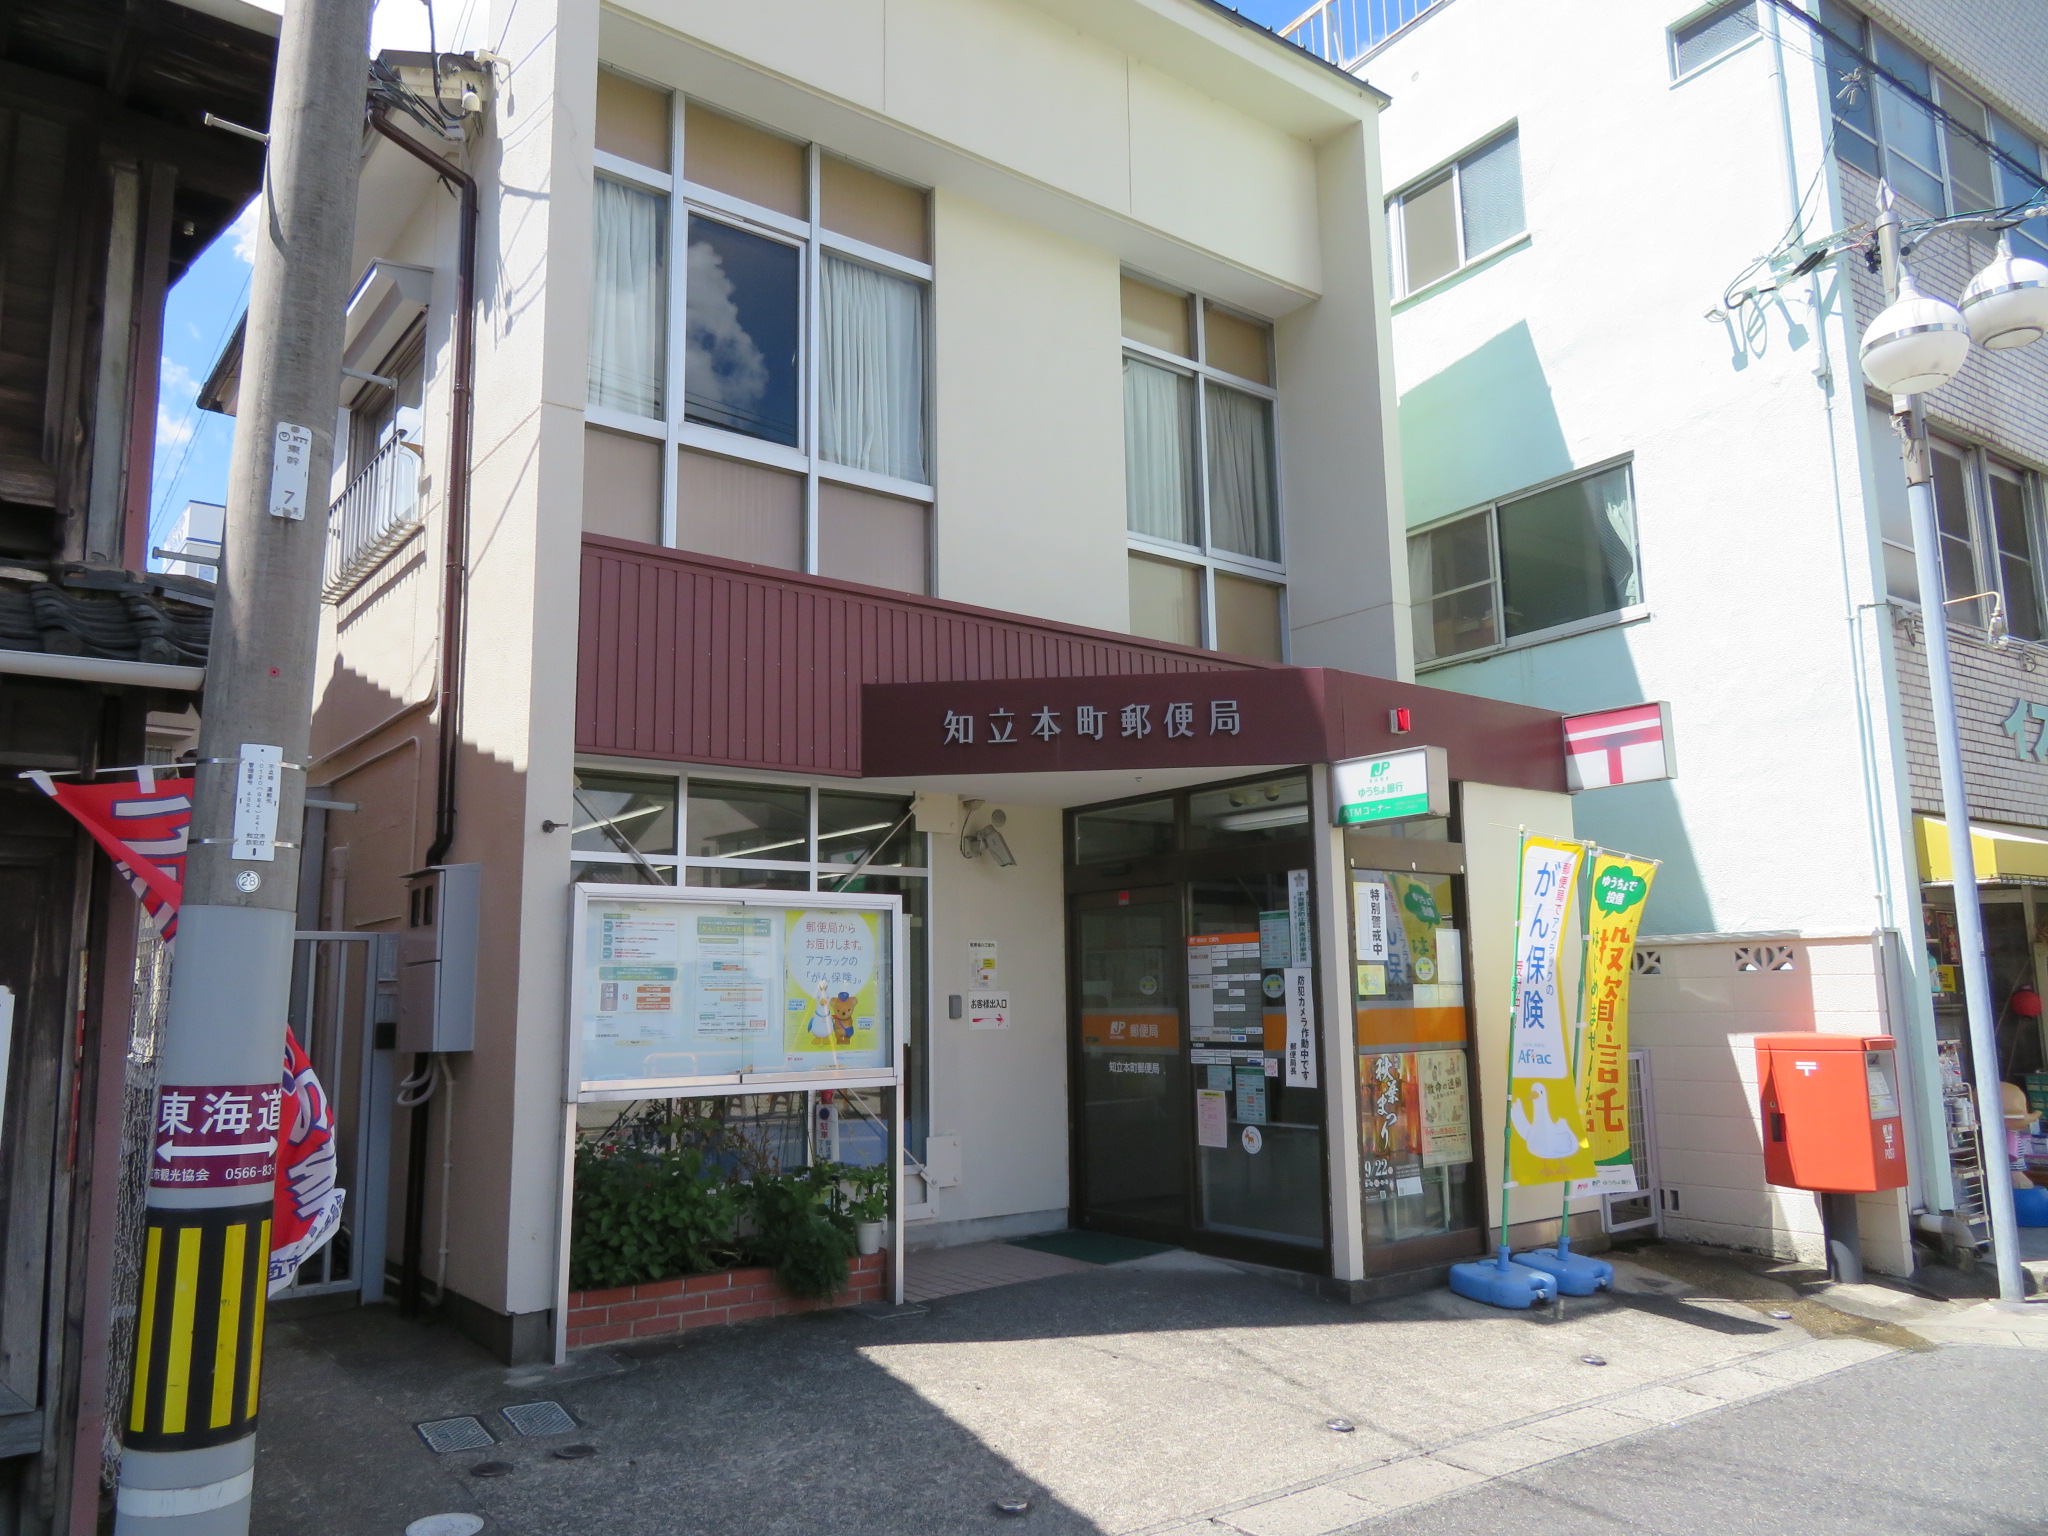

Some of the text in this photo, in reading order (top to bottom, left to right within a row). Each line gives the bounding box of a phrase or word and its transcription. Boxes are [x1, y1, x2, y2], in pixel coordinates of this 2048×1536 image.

[284, 490, 295, 504] 7
[943, 700, 1241, 745] 知立本町郵便局
[1358, 781, 1403, 798] ゆうちょ銀行
[1342, 805, 1391, 818] ATMコーナー
[241, 876, 257, 887] 28
[1601, 875, 1639, 892] ゆうちょで
[1605, 890, 1626, 906] 投信
[805, 921, 856, 934] 郵便局から
[1369, 888, 1383, 956] 特別警戒中
[805, 938, 862, 951] お届けします。
[1522, 861, 1562, 1030] がん保険
[805, 955, 858, 967] アフラックの
[806, 971, 862, 985] 「がん保険」。
[970, 999, 1007, 1009] お客様出入口
[1129, 1024, 1159, 1038] 郵便局
[1297, 975, 1310, 1081] 防犯カメラ作動中です
[1289, 1042, 1297, 1075] 郵便局長
[1108, 1061, 1160, 1075] 知立本町郵便局
[1375, 1055, 1400, 1150] 秋葉まつり
[158, 1091, 282, 1136] 東海道
[1364, 1158, 1388, 1178] 9/22
